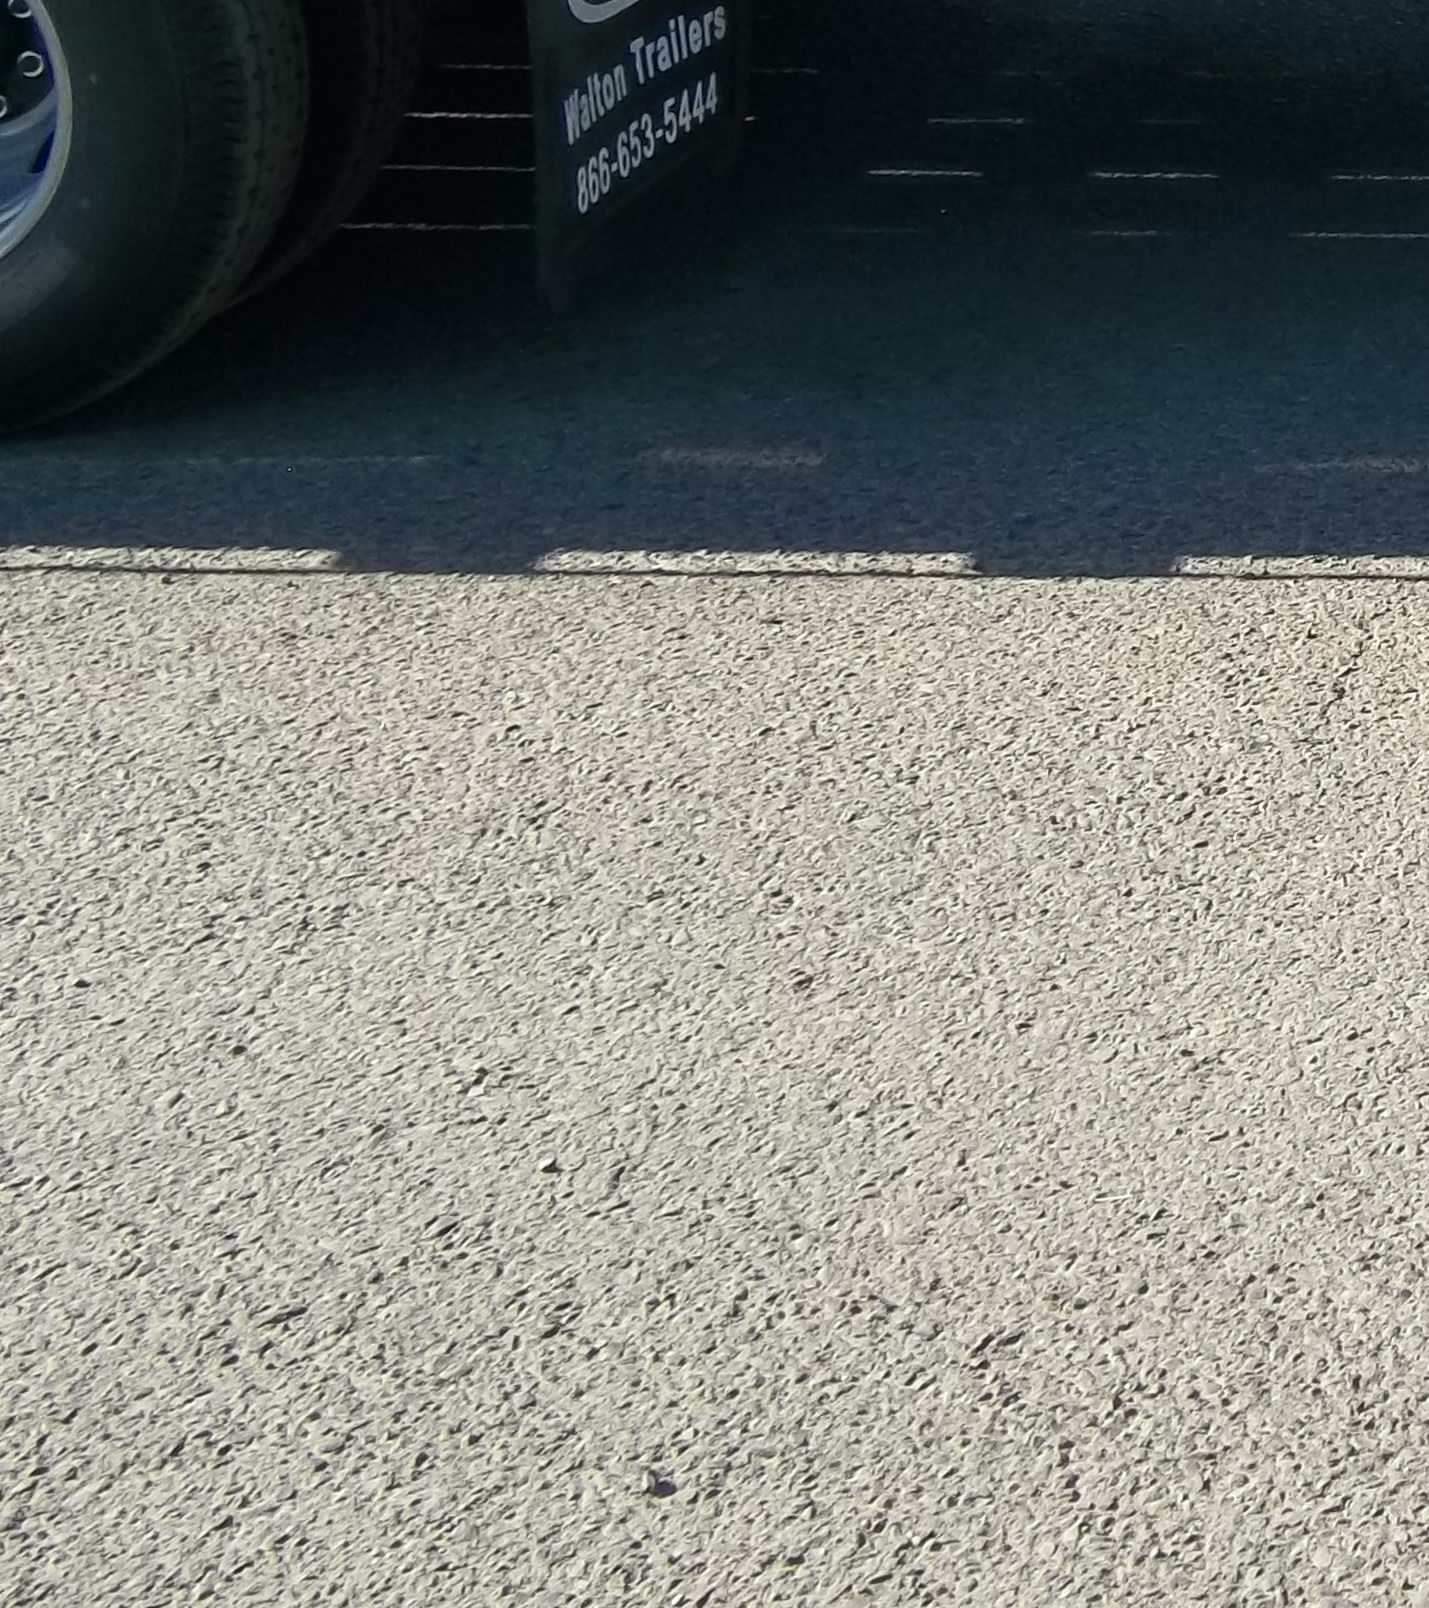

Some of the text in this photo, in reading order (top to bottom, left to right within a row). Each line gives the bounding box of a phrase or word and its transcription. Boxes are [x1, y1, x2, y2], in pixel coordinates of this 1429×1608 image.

[564, 5, 725, 145] Walton Trailers
[577, 71, 718, 215] 866-653-5444
